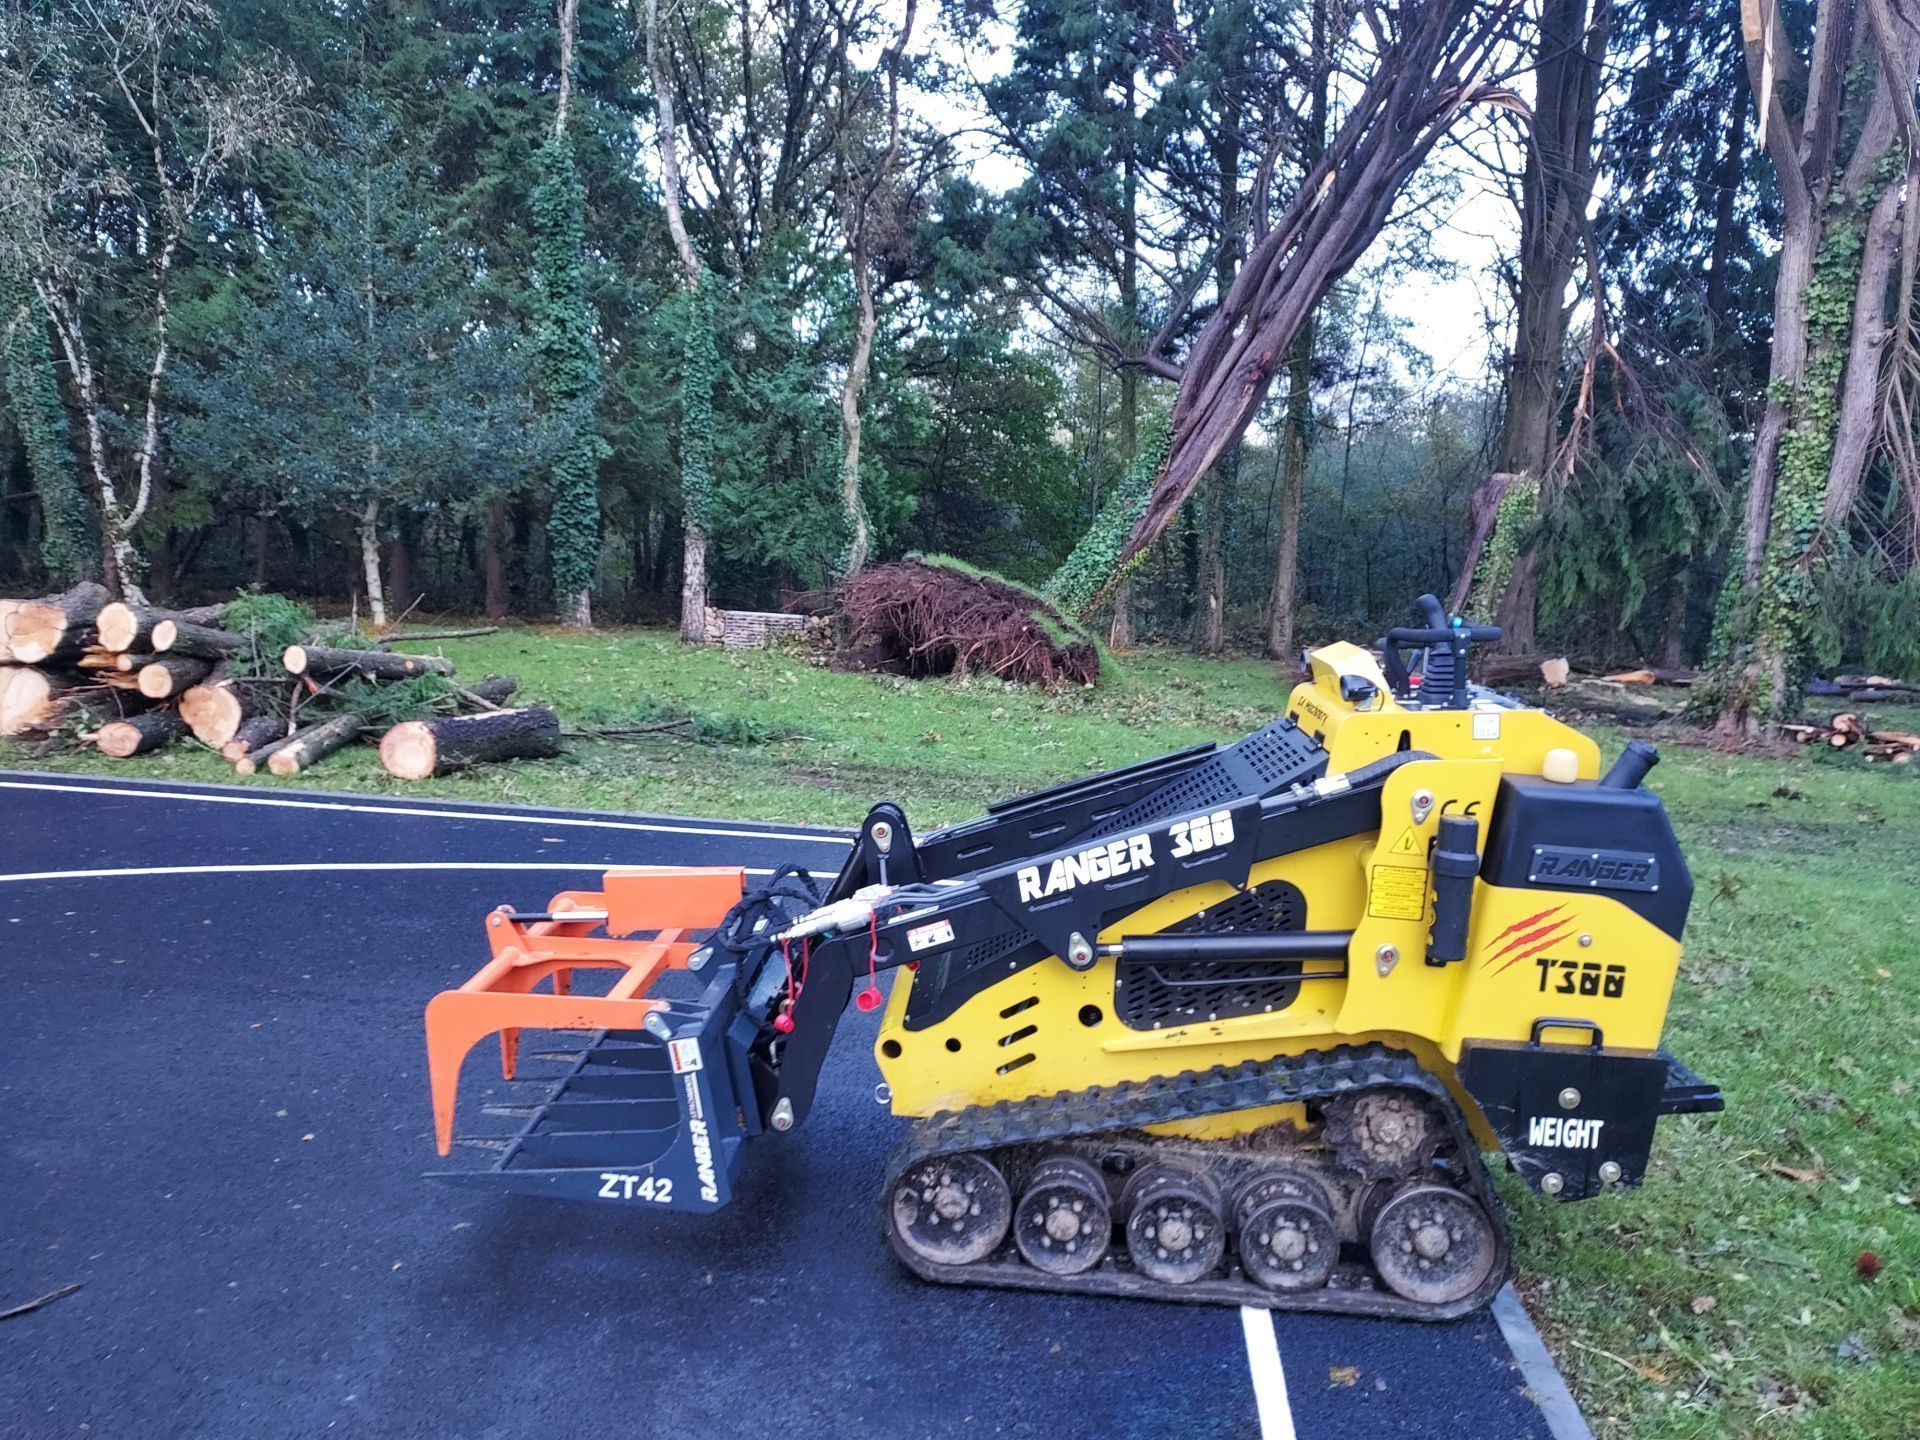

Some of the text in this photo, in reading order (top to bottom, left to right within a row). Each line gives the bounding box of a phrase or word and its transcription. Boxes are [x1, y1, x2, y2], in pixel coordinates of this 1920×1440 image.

[1017, 809, 1235, 903] RANGER 300
[1538, 856, 1652, 882] RANGER
[1536, 958, 1626, 998] T300
[1528, 1116, 1604, 1149] WEIGHT
[689, 1118, 719, 1203] RANGER
[598, 1172, 673, 1203] ZT42
